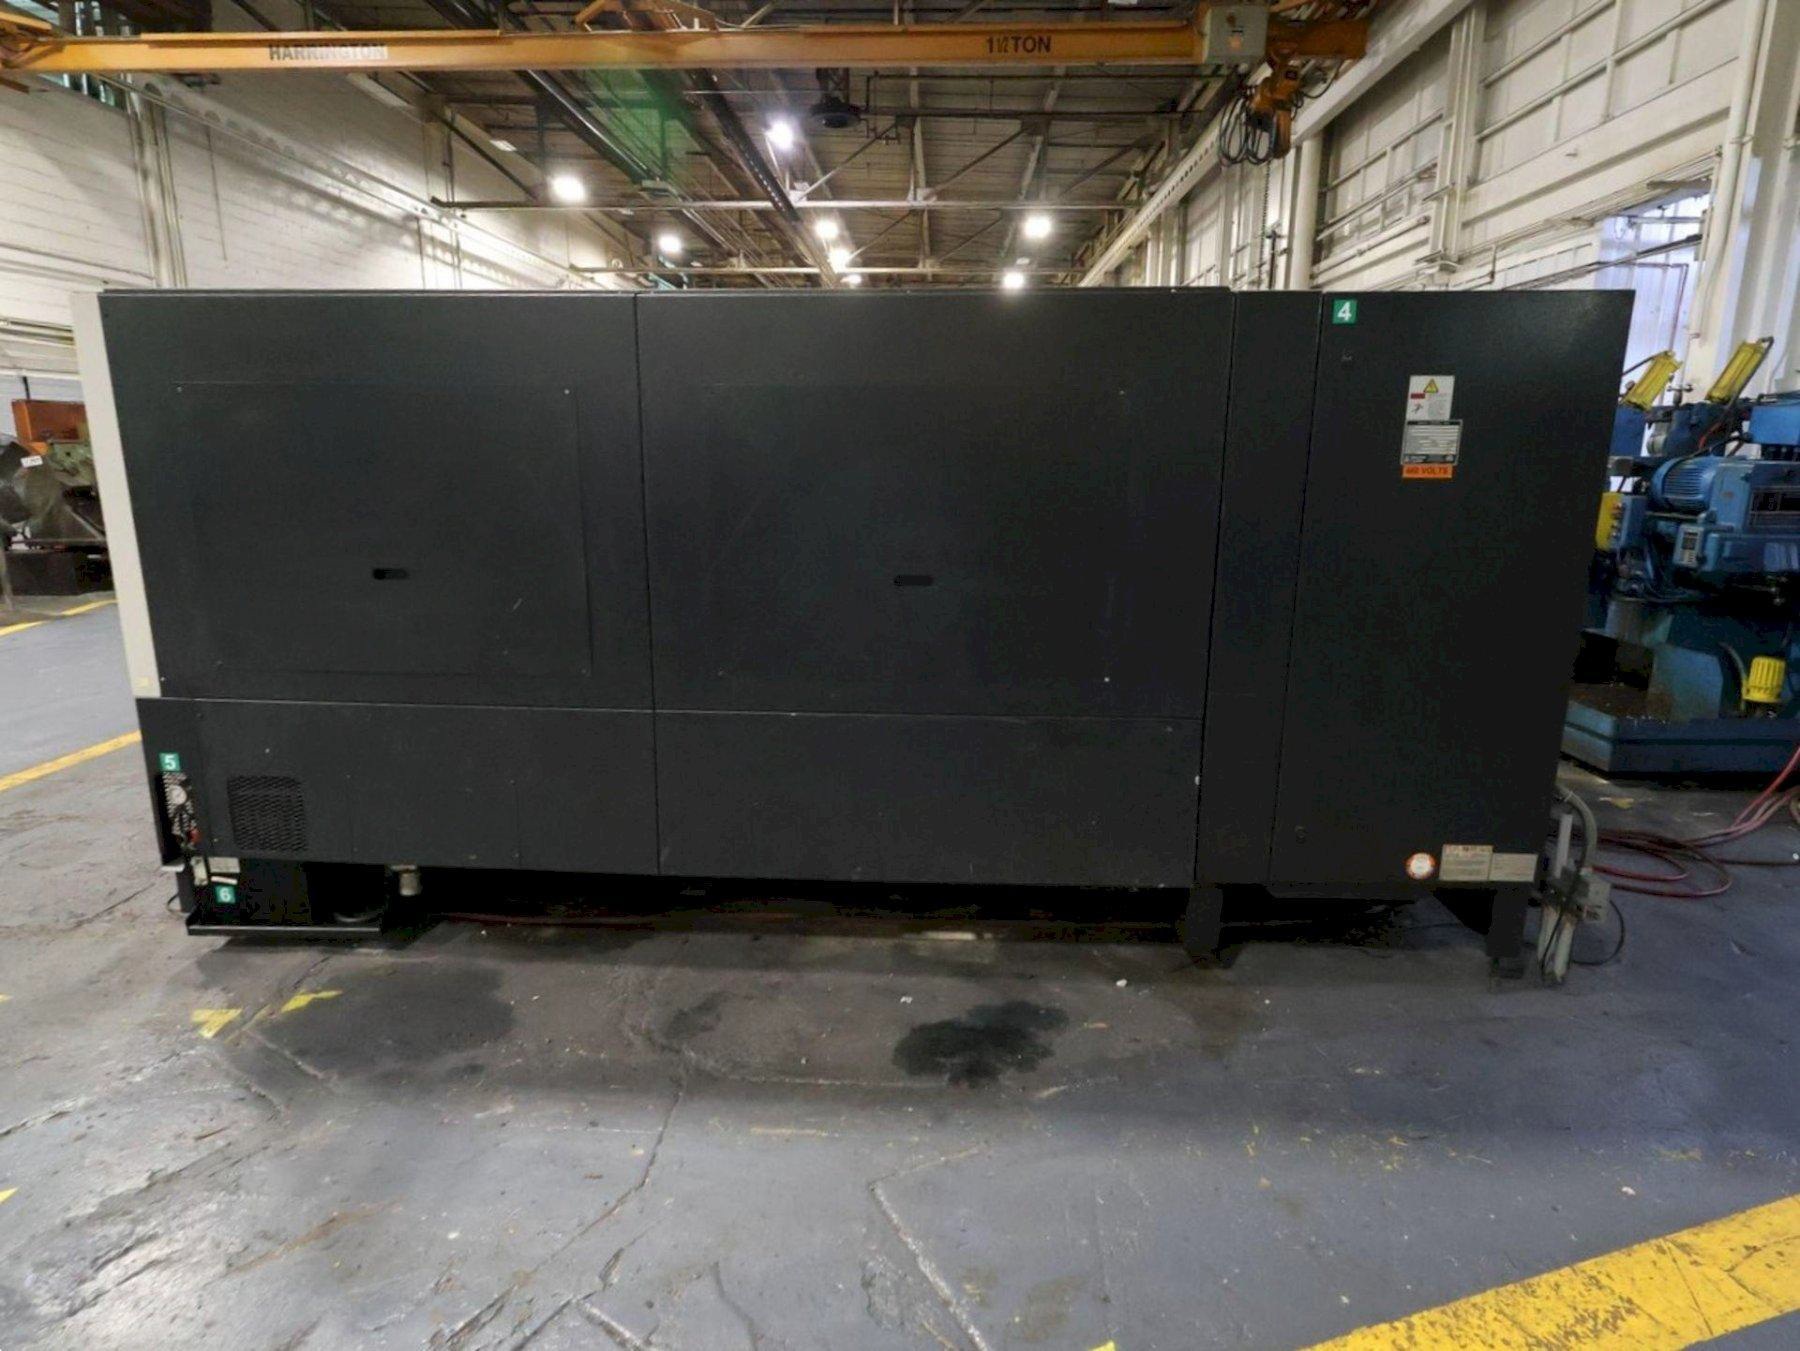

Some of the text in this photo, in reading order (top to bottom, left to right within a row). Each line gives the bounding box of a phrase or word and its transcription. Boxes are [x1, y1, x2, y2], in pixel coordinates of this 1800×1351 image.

[268, 43, 388, 60] HARRINGTON
[1337, 301, 1352, 321] 4
[164, 754, 176, 770] 5
[219, 887, 231, 902] 6
